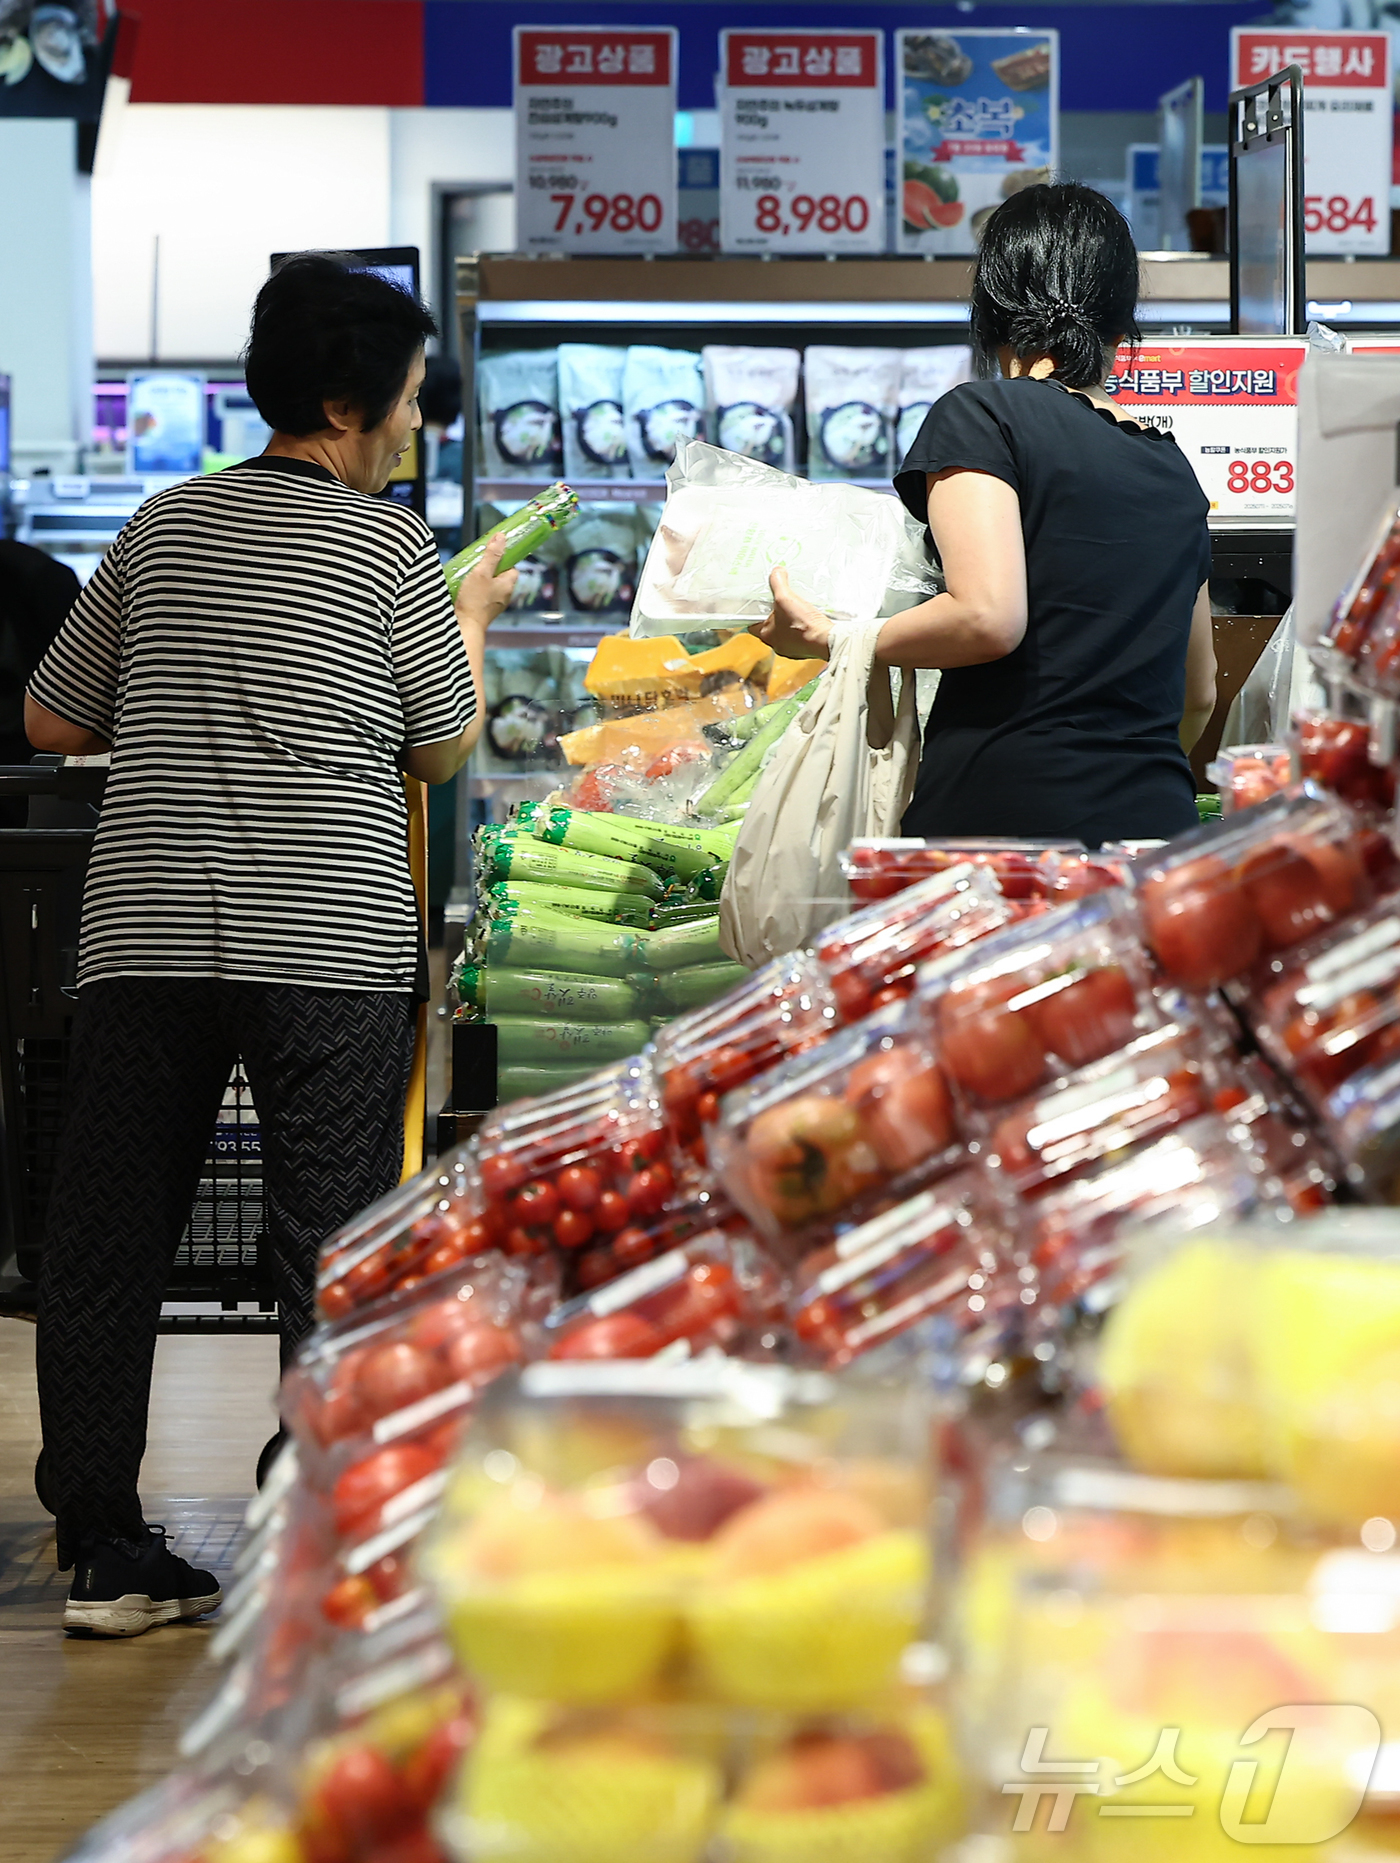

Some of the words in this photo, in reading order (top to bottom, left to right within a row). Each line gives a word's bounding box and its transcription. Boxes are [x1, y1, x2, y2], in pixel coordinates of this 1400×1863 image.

[535, 44, 656, 74] 광고상품
[742, 45, 863, 76] 광고상품
[1251, 46, 1375, 77] 카드행사
[735, 113, 768, 129] 900g
[942, 97, 1015, 139] 초복
[736, 175, 782, 190] 11,980
[550, 193, 663, 236] 7,980
[755, 193, 870, 236] 8,980
[1305, 196, 1377, 233] 584
[1138, 354, 1162, 362] emart
[1188, 369, 1276, 395] 할인지원
[1133, 415, 1173, 428] 박(개)
[1227, 460, 1295, 494] 883
